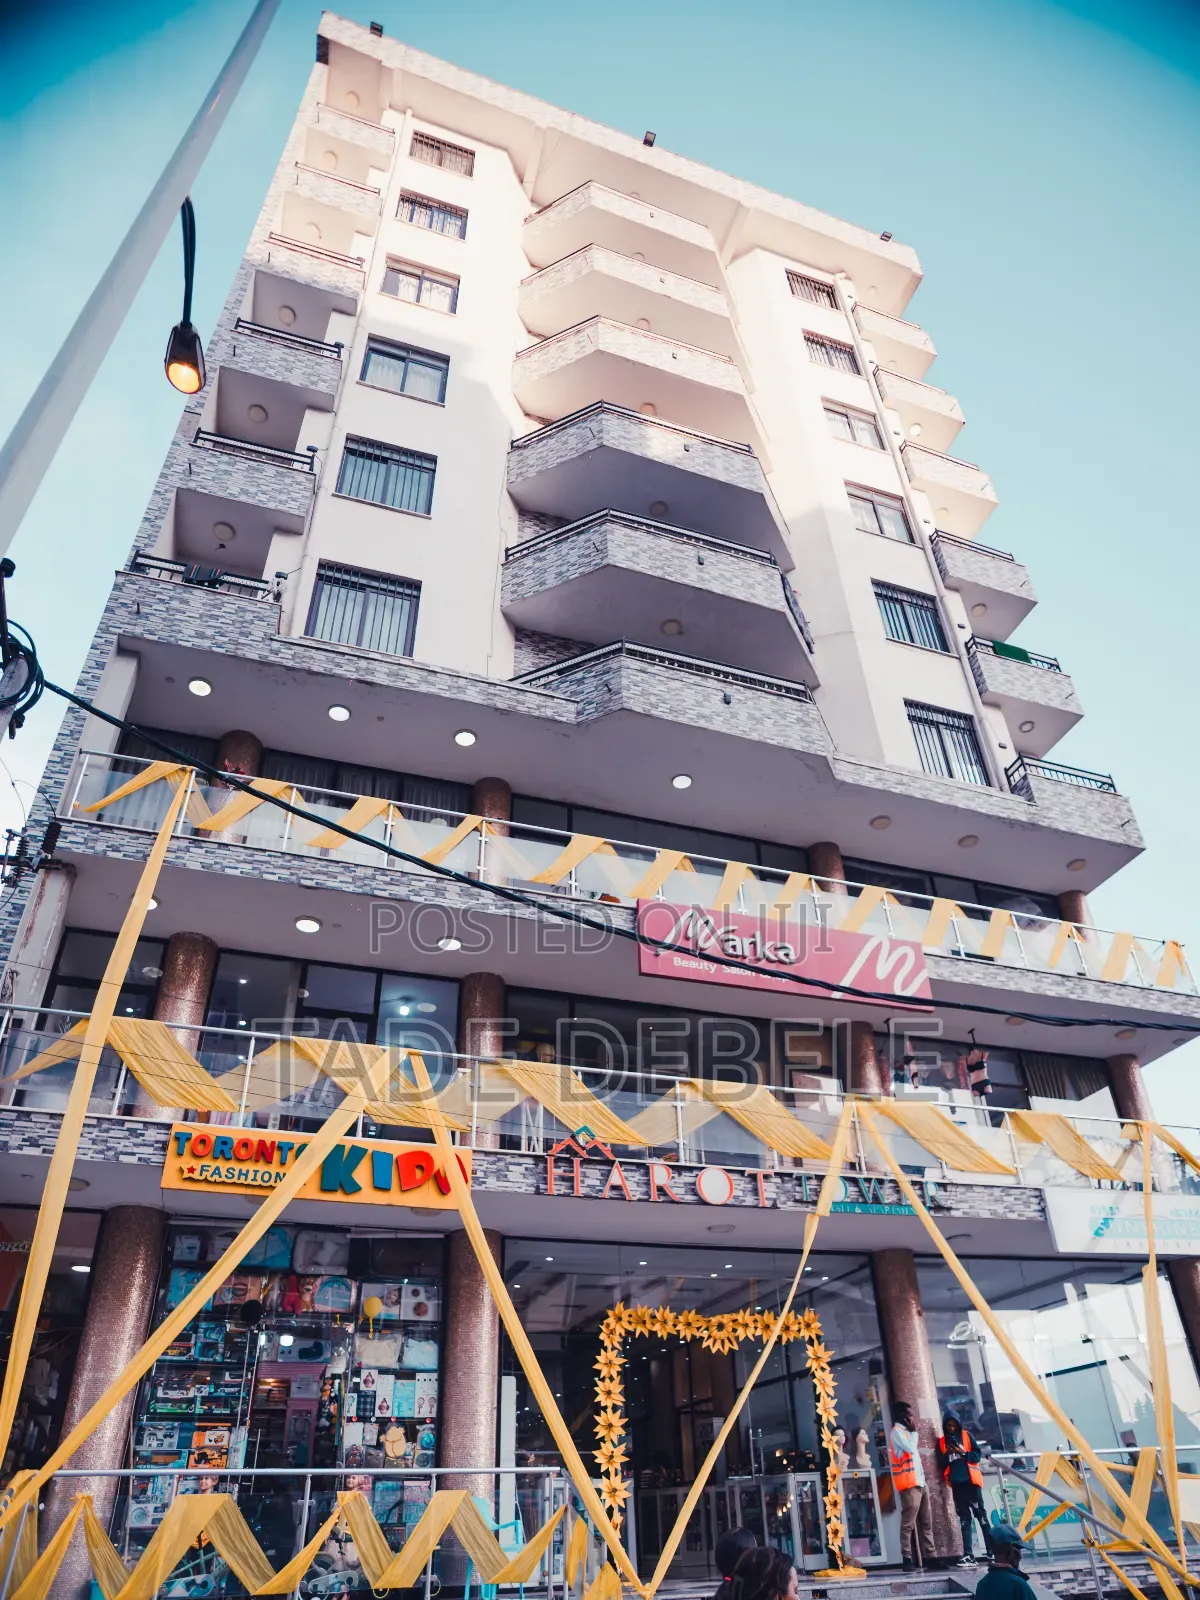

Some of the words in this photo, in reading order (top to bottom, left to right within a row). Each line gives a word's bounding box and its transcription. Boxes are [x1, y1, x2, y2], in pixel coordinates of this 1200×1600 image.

[655, 908, 796, 965] Marka
[673, 956, 717, 974] Beauty
[174, 1131, 311, 1166] TORONT
[547, 1156, 775, 1208] HAROT
